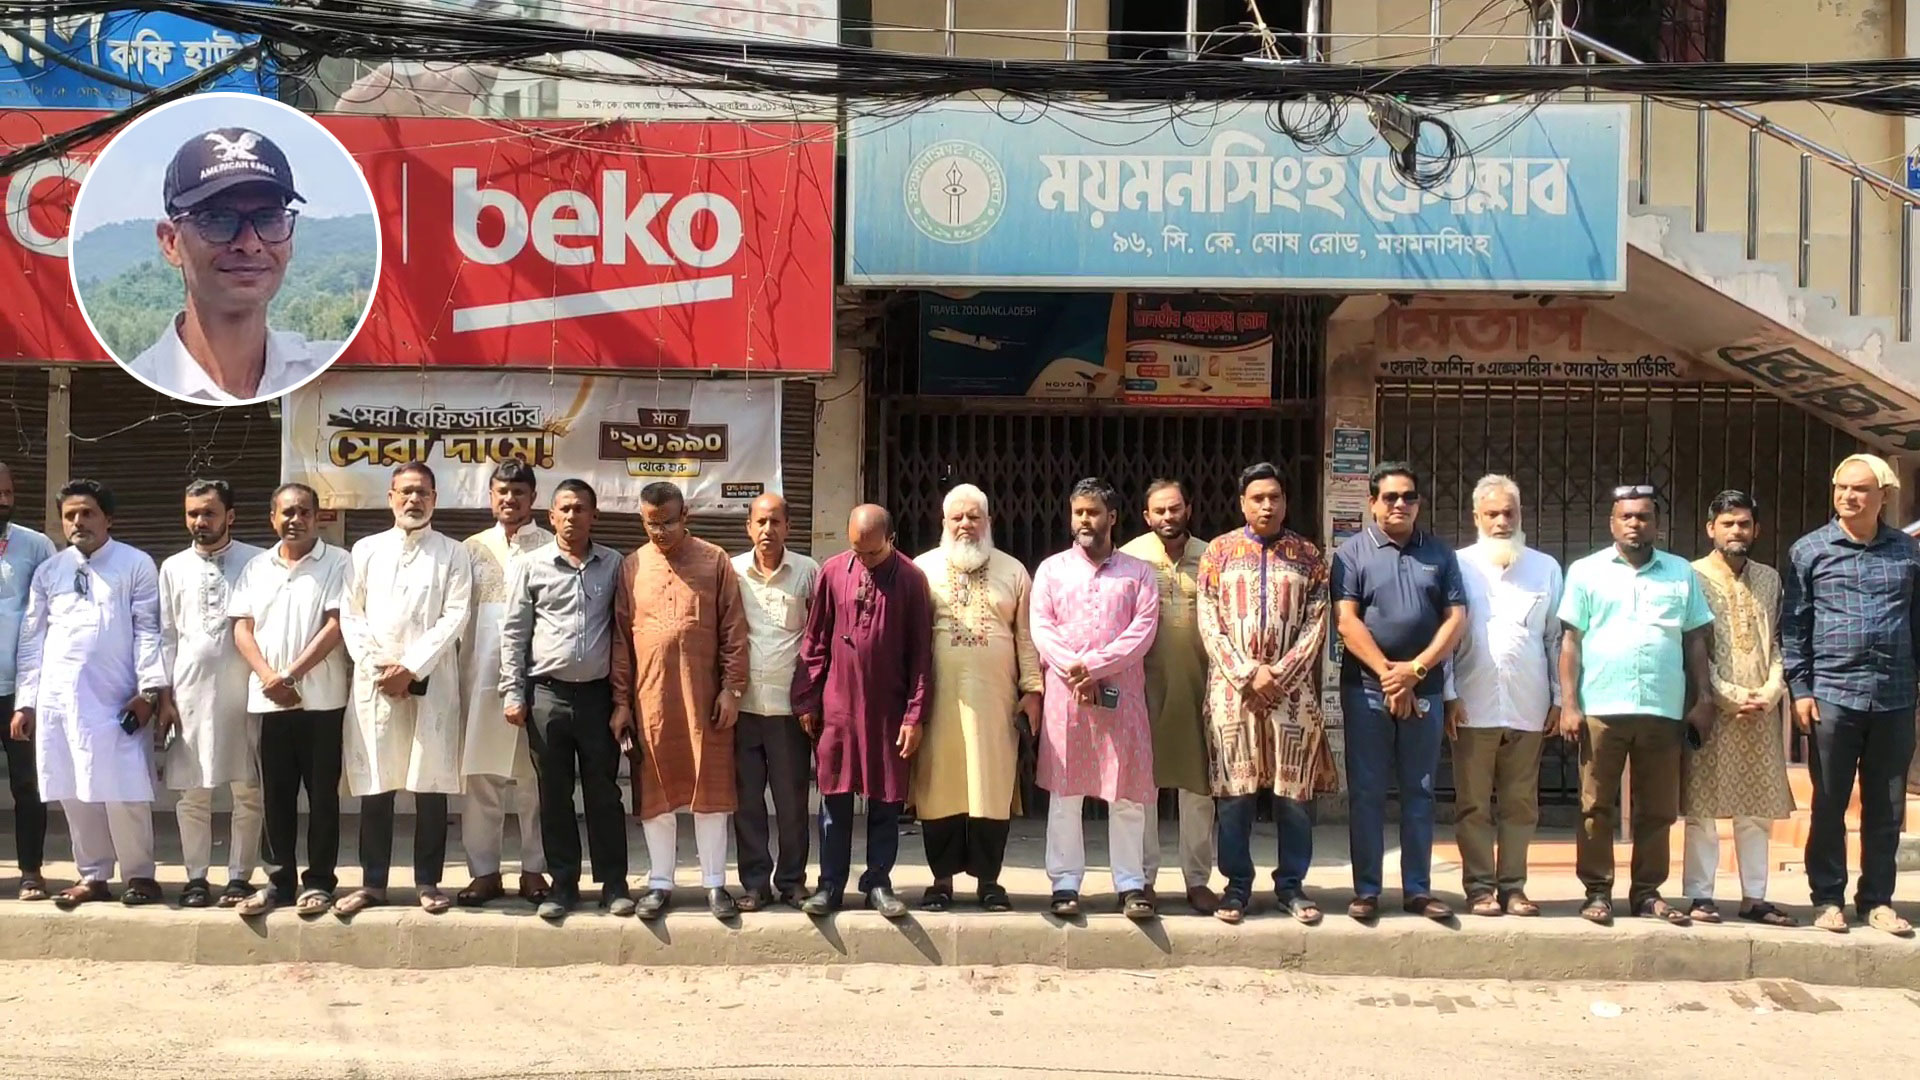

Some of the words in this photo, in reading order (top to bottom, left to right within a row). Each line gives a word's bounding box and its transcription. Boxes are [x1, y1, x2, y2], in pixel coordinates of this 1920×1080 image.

[107, 28, 176, 76] কফি
[200, 161, 249, 180] AMERICAN
[1037, 130, 1347, 228] ময়মনসিংহ
[453, 167, 742, 268] beko
[1112, 230, 1152, 258] ৯৬,
[1162, 226, 1193, 254] সি.
[1205, 230, 1241, 255] কে.
[1252, 230, 1301, 255] ঘোষ
[1309, 230, 1367, 259] রোড,
[1376, 226, 1492, 258] ময়মনসিংহ
[930, 304, 960, 316] TRAVEL
[1390, 356, 1428, 376] সেলাই
[1431, 355, 1474, 376] মেশিন
[1563, 355, 1618, 378] মোবাইল
[352, 405, 399, 428] সেরা
[406, 402, 542, 429] রেফ্রিজারেটর
[652, 412, 678, 425] মাত্র
[329, 429, 429, 467] সেরা
[441, 430, 554, 469] দামে!
[639, 462, 665, 473] থেকে
[668, 462, 687, 474] শুরু
